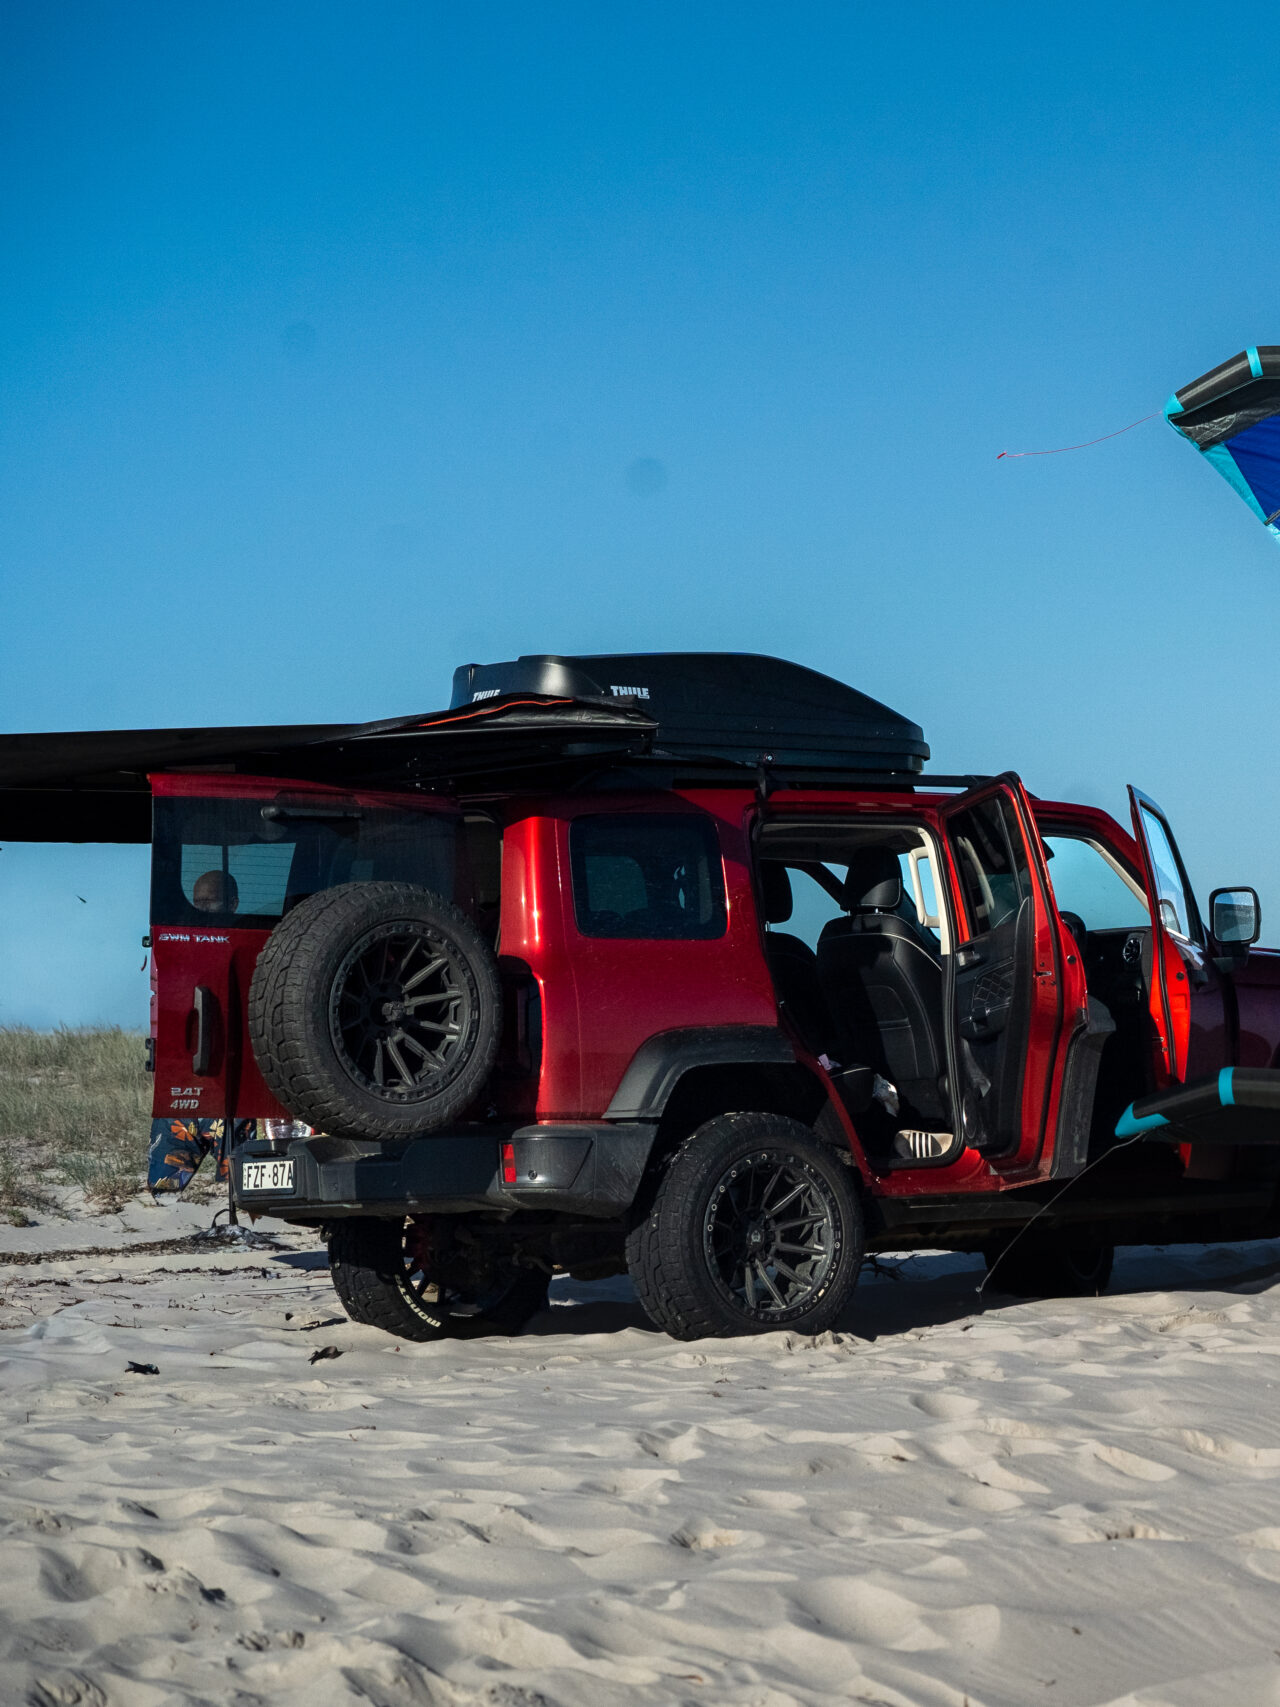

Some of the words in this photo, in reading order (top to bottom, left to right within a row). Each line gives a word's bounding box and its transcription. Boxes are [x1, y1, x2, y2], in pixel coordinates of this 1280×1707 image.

[610, 685, 650, 700] THULE
[192, 934, 231, 944] TANK
[170, 1099, 200, 1110] 4WD
